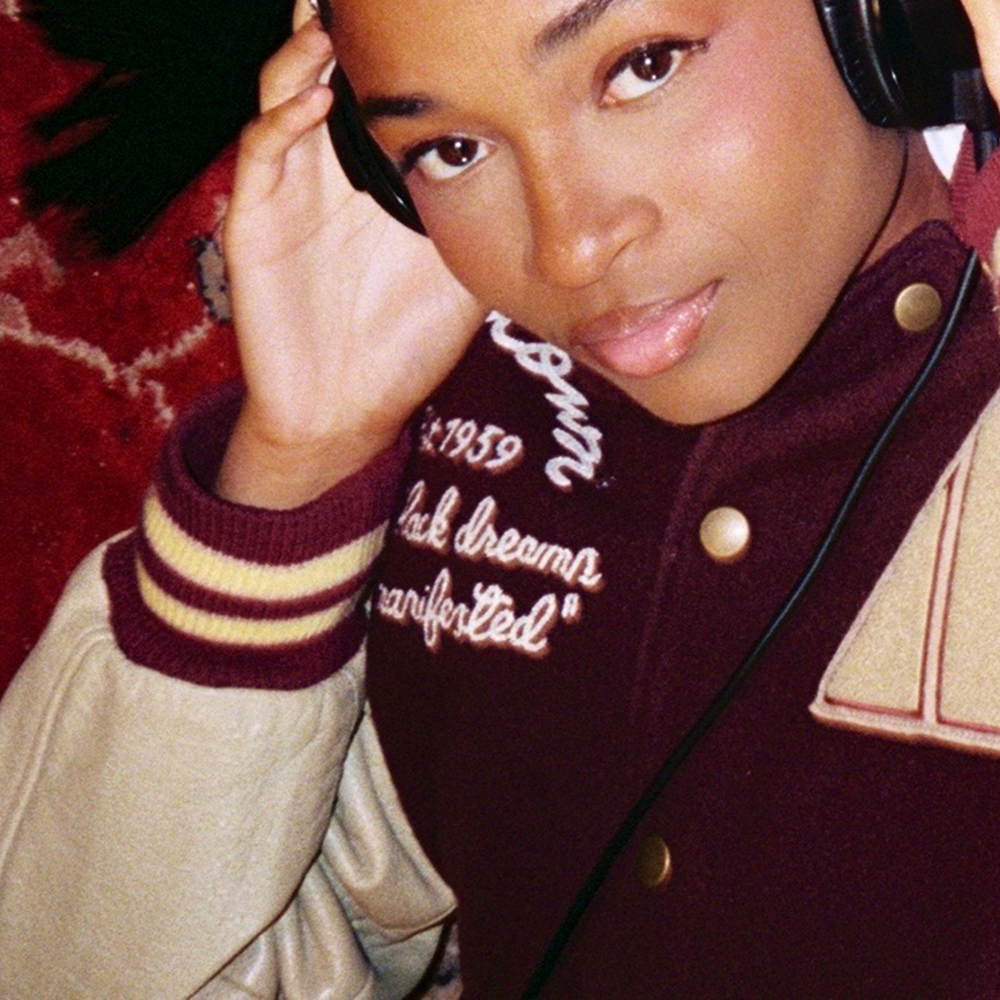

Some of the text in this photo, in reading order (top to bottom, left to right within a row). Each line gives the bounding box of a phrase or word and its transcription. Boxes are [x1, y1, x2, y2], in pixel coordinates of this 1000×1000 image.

[397, 478, 604, 589] lack dreams
[377, 566, 581, 653] anifested"
